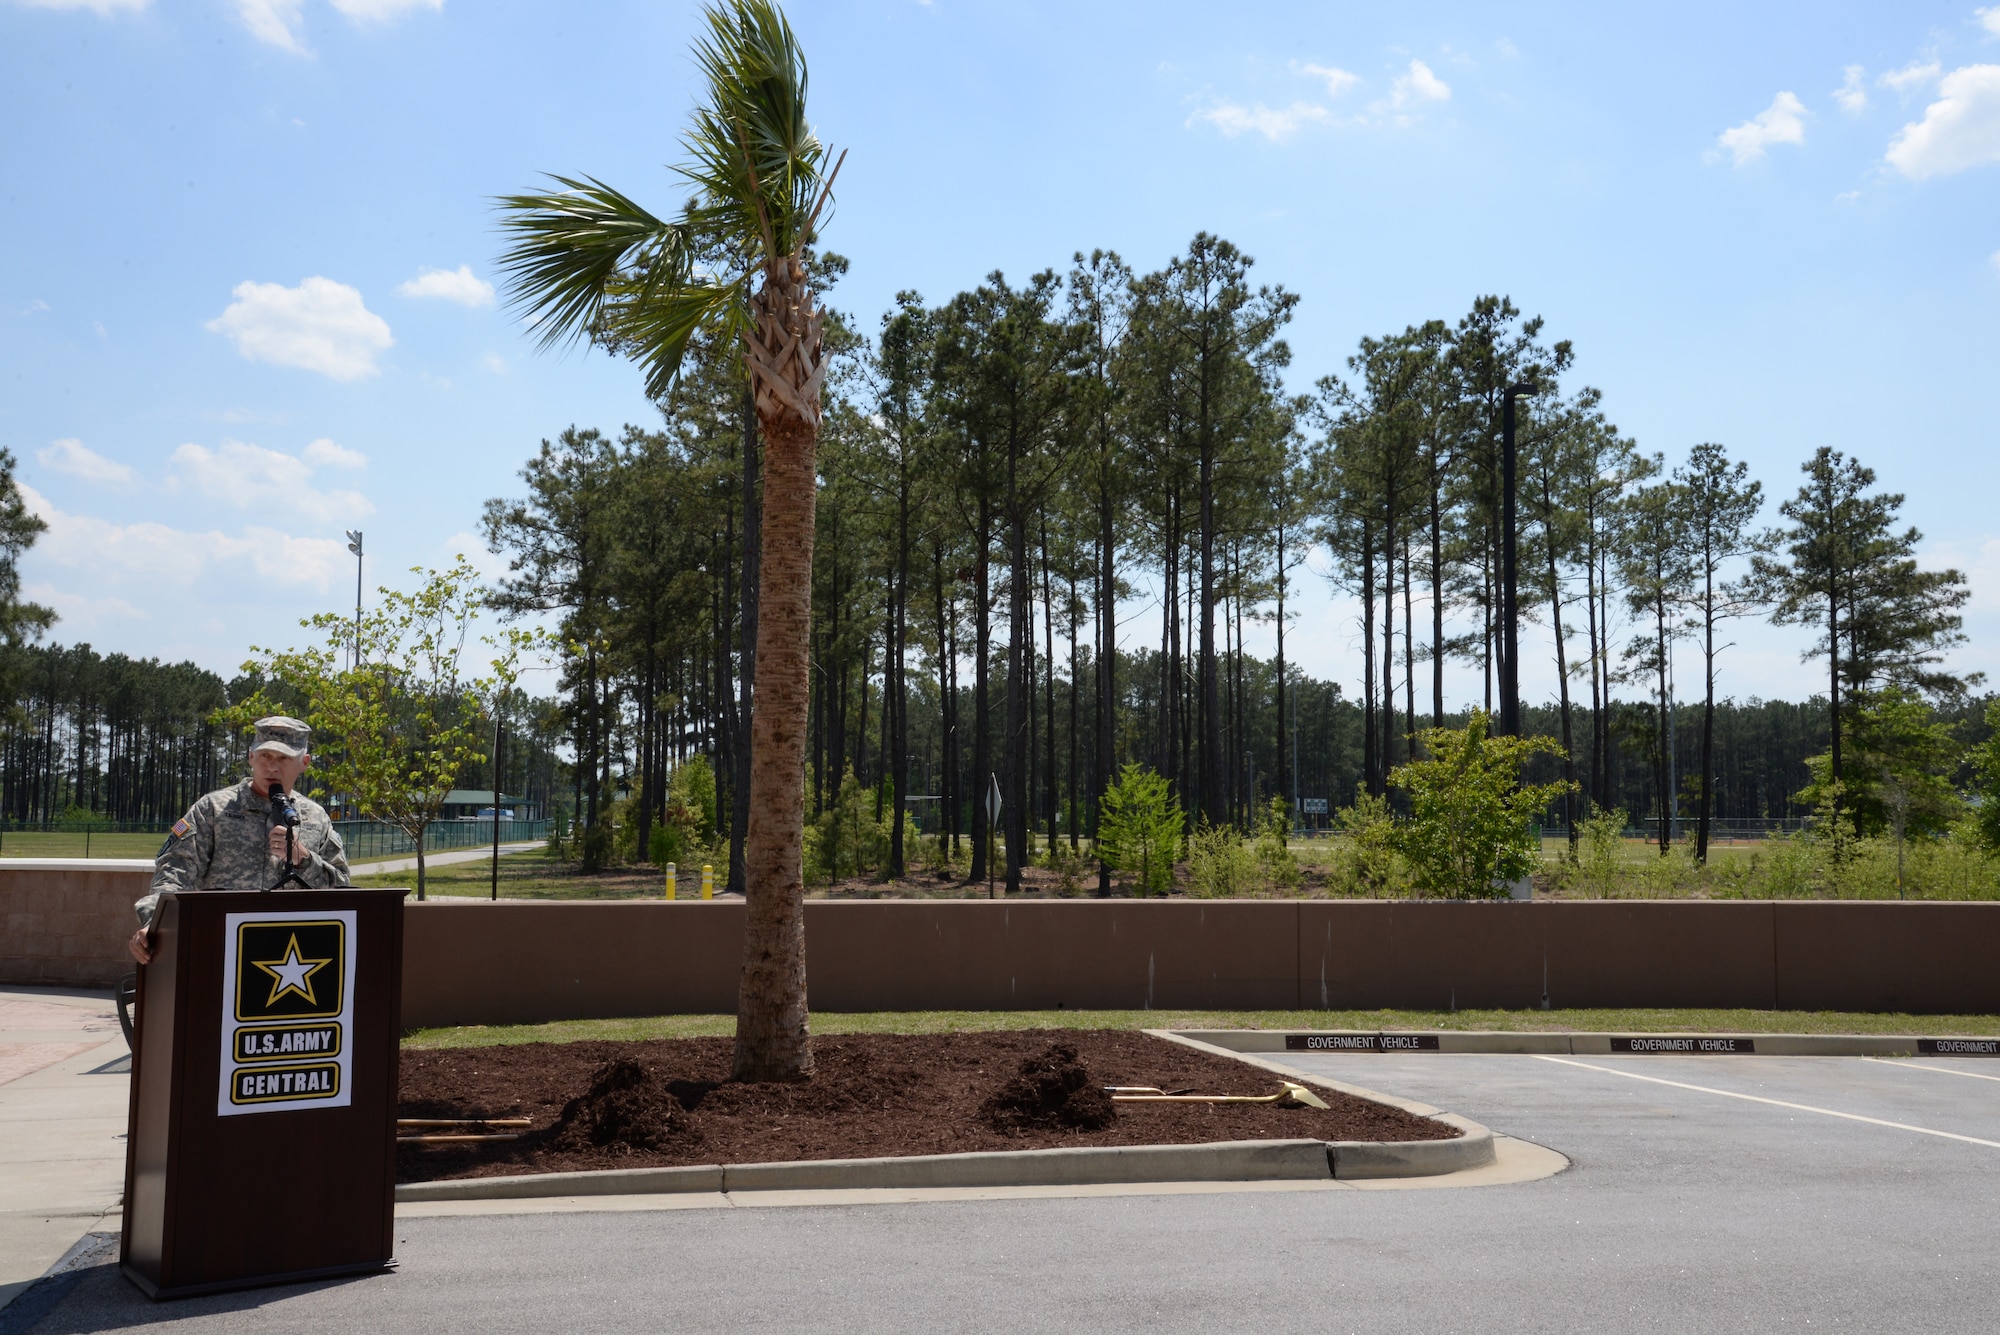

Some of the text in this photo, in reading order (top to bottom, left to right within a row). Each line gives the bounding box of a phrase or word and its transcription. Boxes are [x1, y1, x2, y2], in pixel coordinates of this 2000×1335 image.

[1307, 1037, 1419, 1048] GOVERNMENT VEHICLE
[1630, 1040, 1735, 1051] GOVERNMENT VEHICLE
[1936, 1041, 1997, 1053] GOVERNMENT
[242, 1071, 330, 1095] CENTRAL
